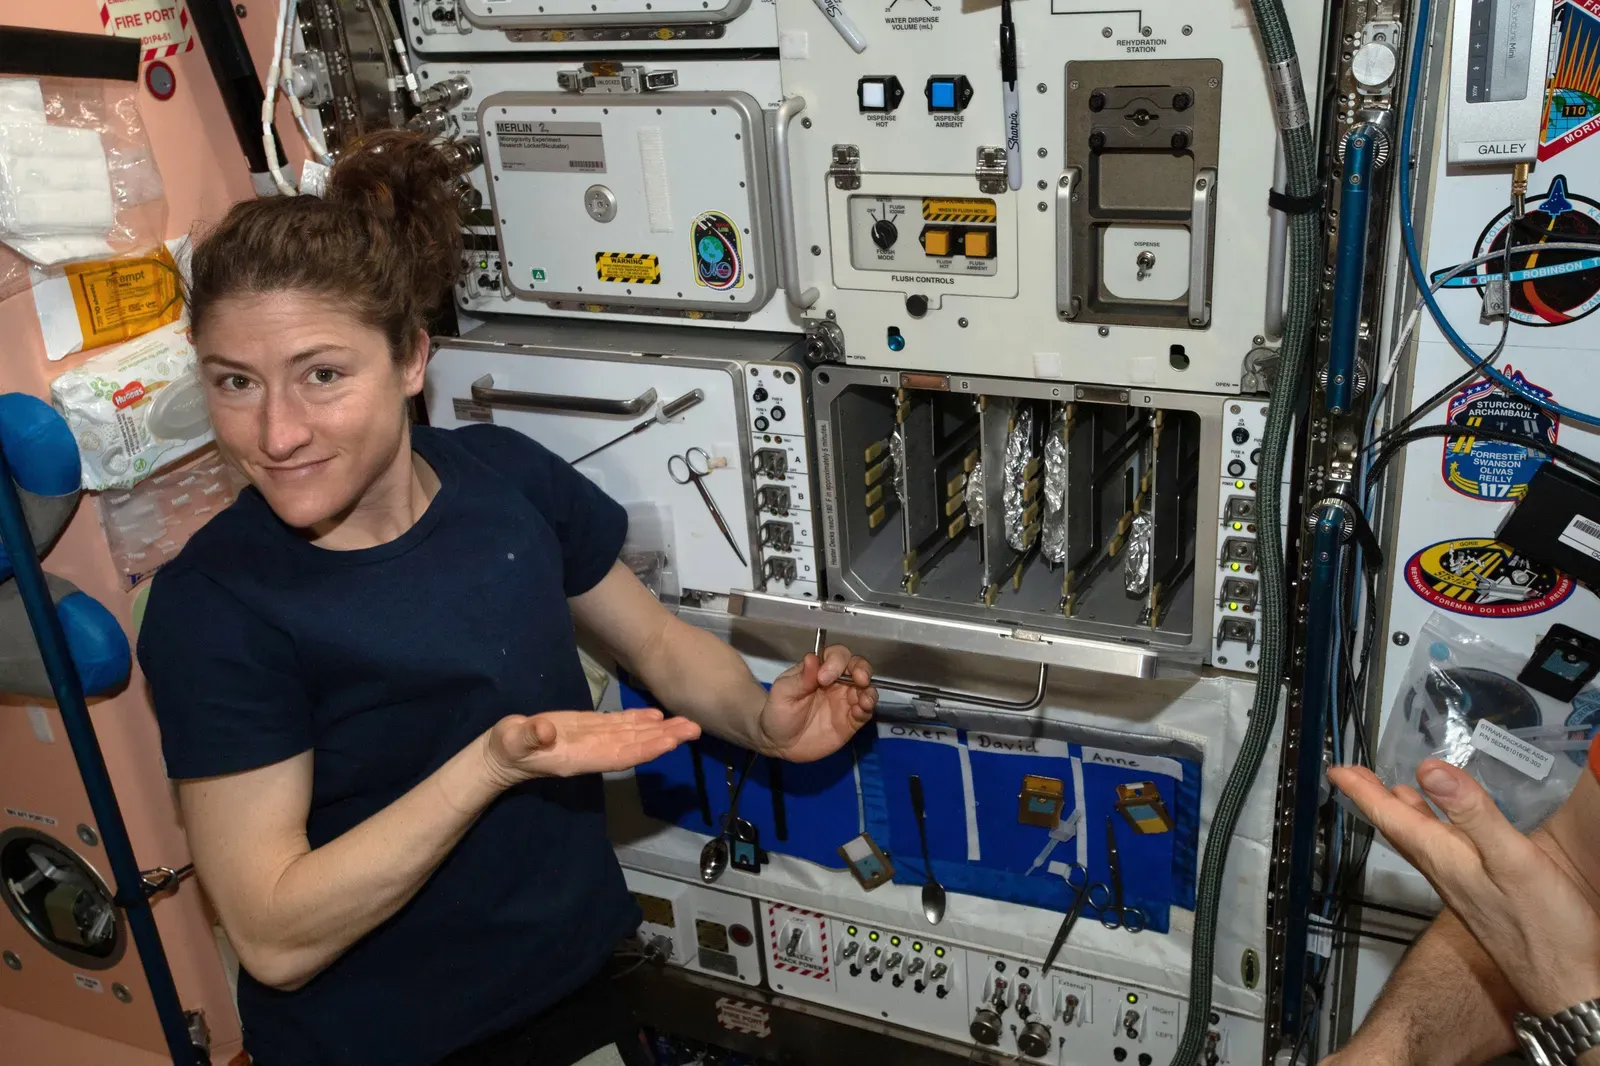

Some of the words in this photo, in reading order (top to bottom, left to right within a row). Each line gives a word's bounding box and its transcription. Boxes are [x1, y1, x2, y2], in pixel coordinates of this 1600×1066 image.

[114, 13, 143, 30] FIRE
[144, 7, 176, 25] PORT
[919, 23, 933, 31] (mL)
[1508, 42, 1516, 58] Mini
[1564, 105, 1586, 116] 110
[496, 123, 533, 132] MERLIN
[1478, 143, 1526, 154] GALLEY
[1523, 262, 1582, 280] ROBINSON
[962, 381, 968, 389] B
[1052, 388, 1059, 396] C
[1477, 401, 1532, 411] STURCKOW
[1468, 409, 1539, 419] ARCHAMBAULT
[1471, 450, 1526, 460] FORRESTER
[1473, 458, 1521, 468] SWANSON
[823, 454, 832, 492] approximately
[1480, 466, 1513, 475] OLIVAS
[1479, 474, 1512, 483] REILLY
[1480, 483, 1511, 497] 117
[1433, 570, 1472, 586] STS-123
[1411, 566, 1430, 597] BEHNKEN
[1434, 595, 1474, 611] FOREMAN
[1502, 601, 1546, 613] LINNEHAN
[1479, 732, 1490, 742] P/N
[977, 734, 1040, 754] David
[1480, 723, 1503, 739] STRAW
[1502, 735, 1532, 753] PACKAGE
[1531, 750, 1548, 762] ASSY
[1092, 752, 1140, 768] Anne
[778, 956, 797, 965] RACK
[798, 961, 824, 972] POWER
[1058, 979, 1087, 990] External
[1152, 1006, 1176, 1016] RIGHT
[742, 1015, 762, 1025] PORT
[1155, 1031, 1174, 1040] LEFT
